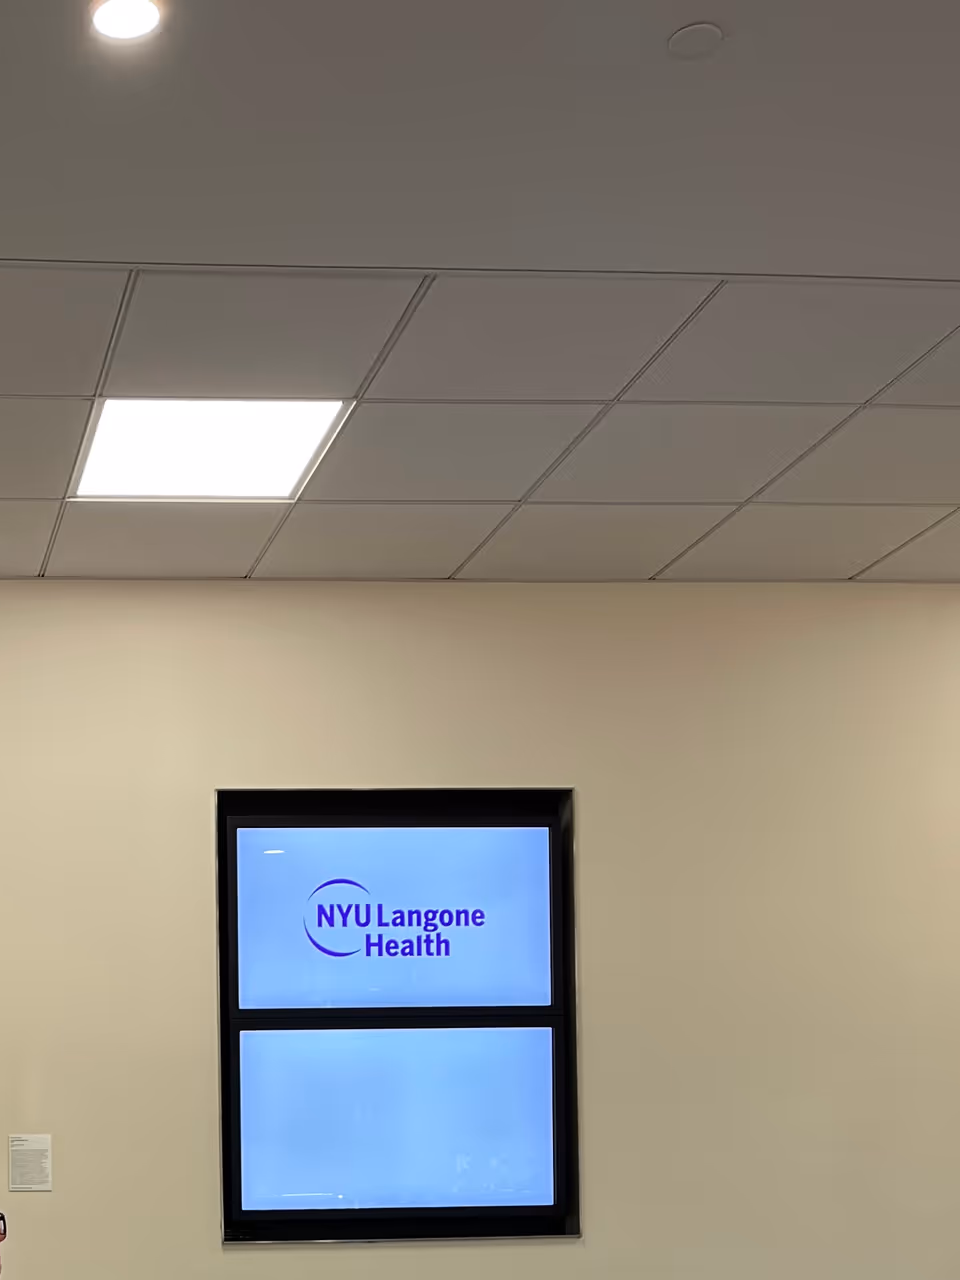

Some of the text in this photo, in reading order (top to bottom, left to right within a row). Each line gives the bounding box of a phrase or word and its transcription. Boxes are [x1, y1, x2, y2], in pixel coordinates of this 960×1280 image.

[317, 903, 486, 932] NYU Langone
[365, 932, 451, 957] Health
